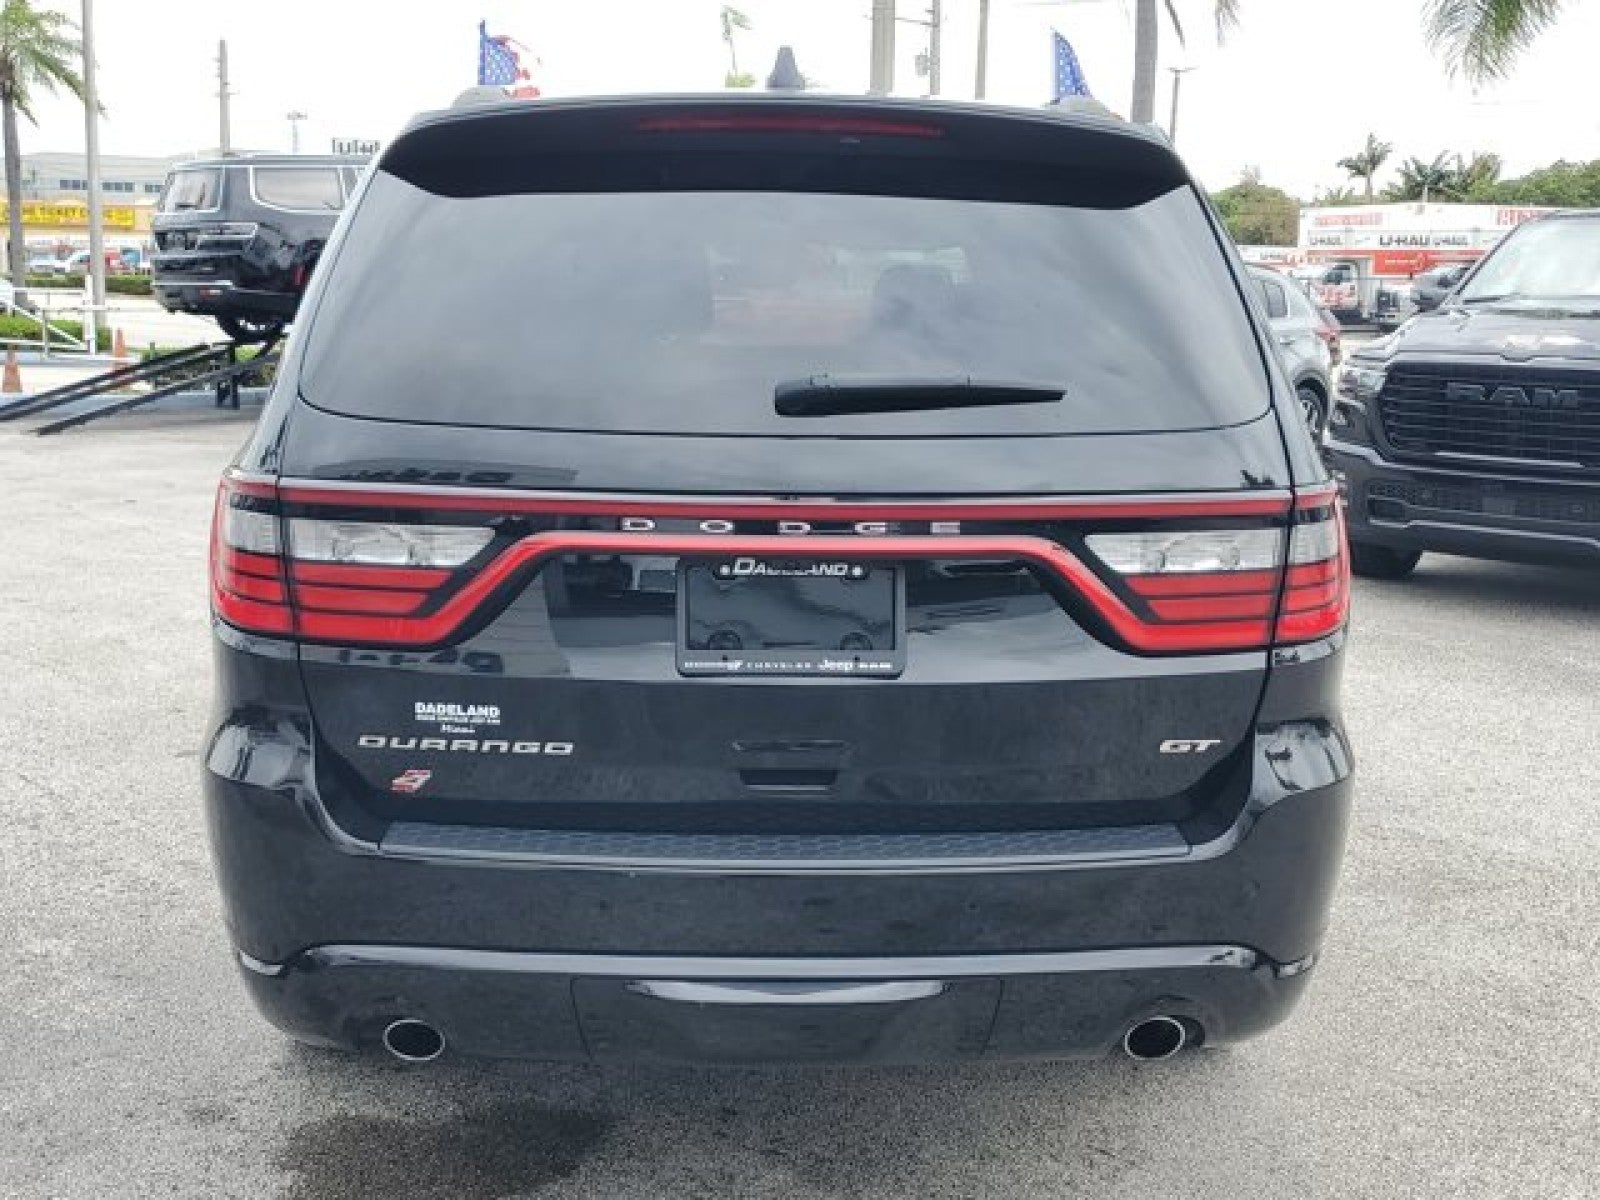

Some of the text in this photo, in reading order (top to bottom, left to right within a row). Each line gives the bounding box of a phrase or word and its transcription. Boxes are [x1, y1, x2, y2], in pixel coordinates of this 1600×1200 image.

[1447, 382, 1578, 407] RAM
[621, 516, 961, 534] DODGE
[358, 735, 573, 755] DURANGO
[1160, 739, 1221, 753] GT
